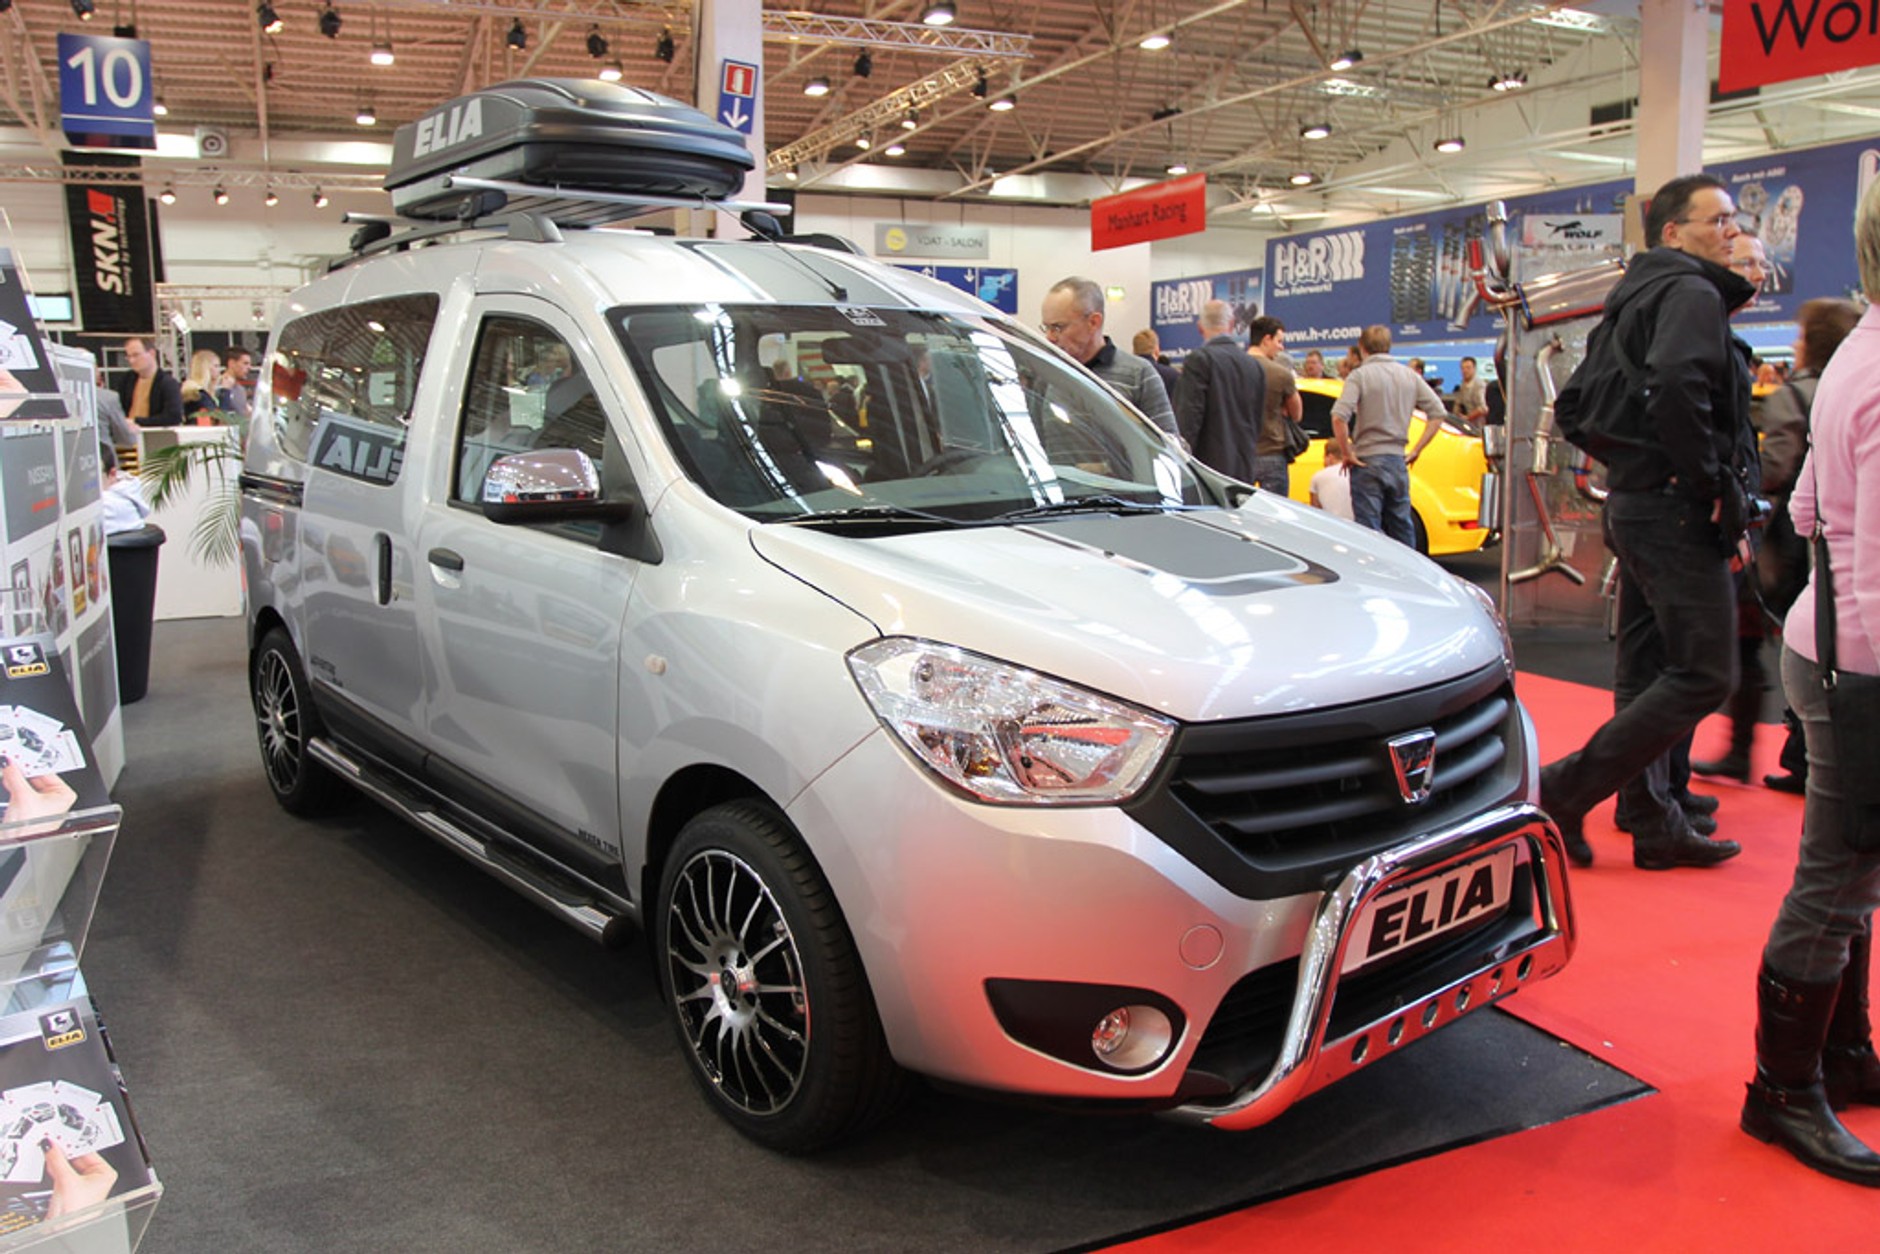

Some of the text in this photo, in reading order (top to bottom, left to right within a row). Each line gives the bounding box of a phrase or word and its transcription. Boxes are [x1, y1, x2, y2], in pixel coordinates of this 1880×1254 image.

[67, 46, 142, 108] 10
[413, 97, 482, 158] ELIA
[1108, 202, 1187, 231] Manhart Racing
[1564, 229, 1603, 239] WOLF
[951, 237, 984, 248] SALON
[1274, 236, 1331, 288] H&R
[1156, 282, 1191, 319] H&R
[1366, 864, 1494, 959] ELIA
